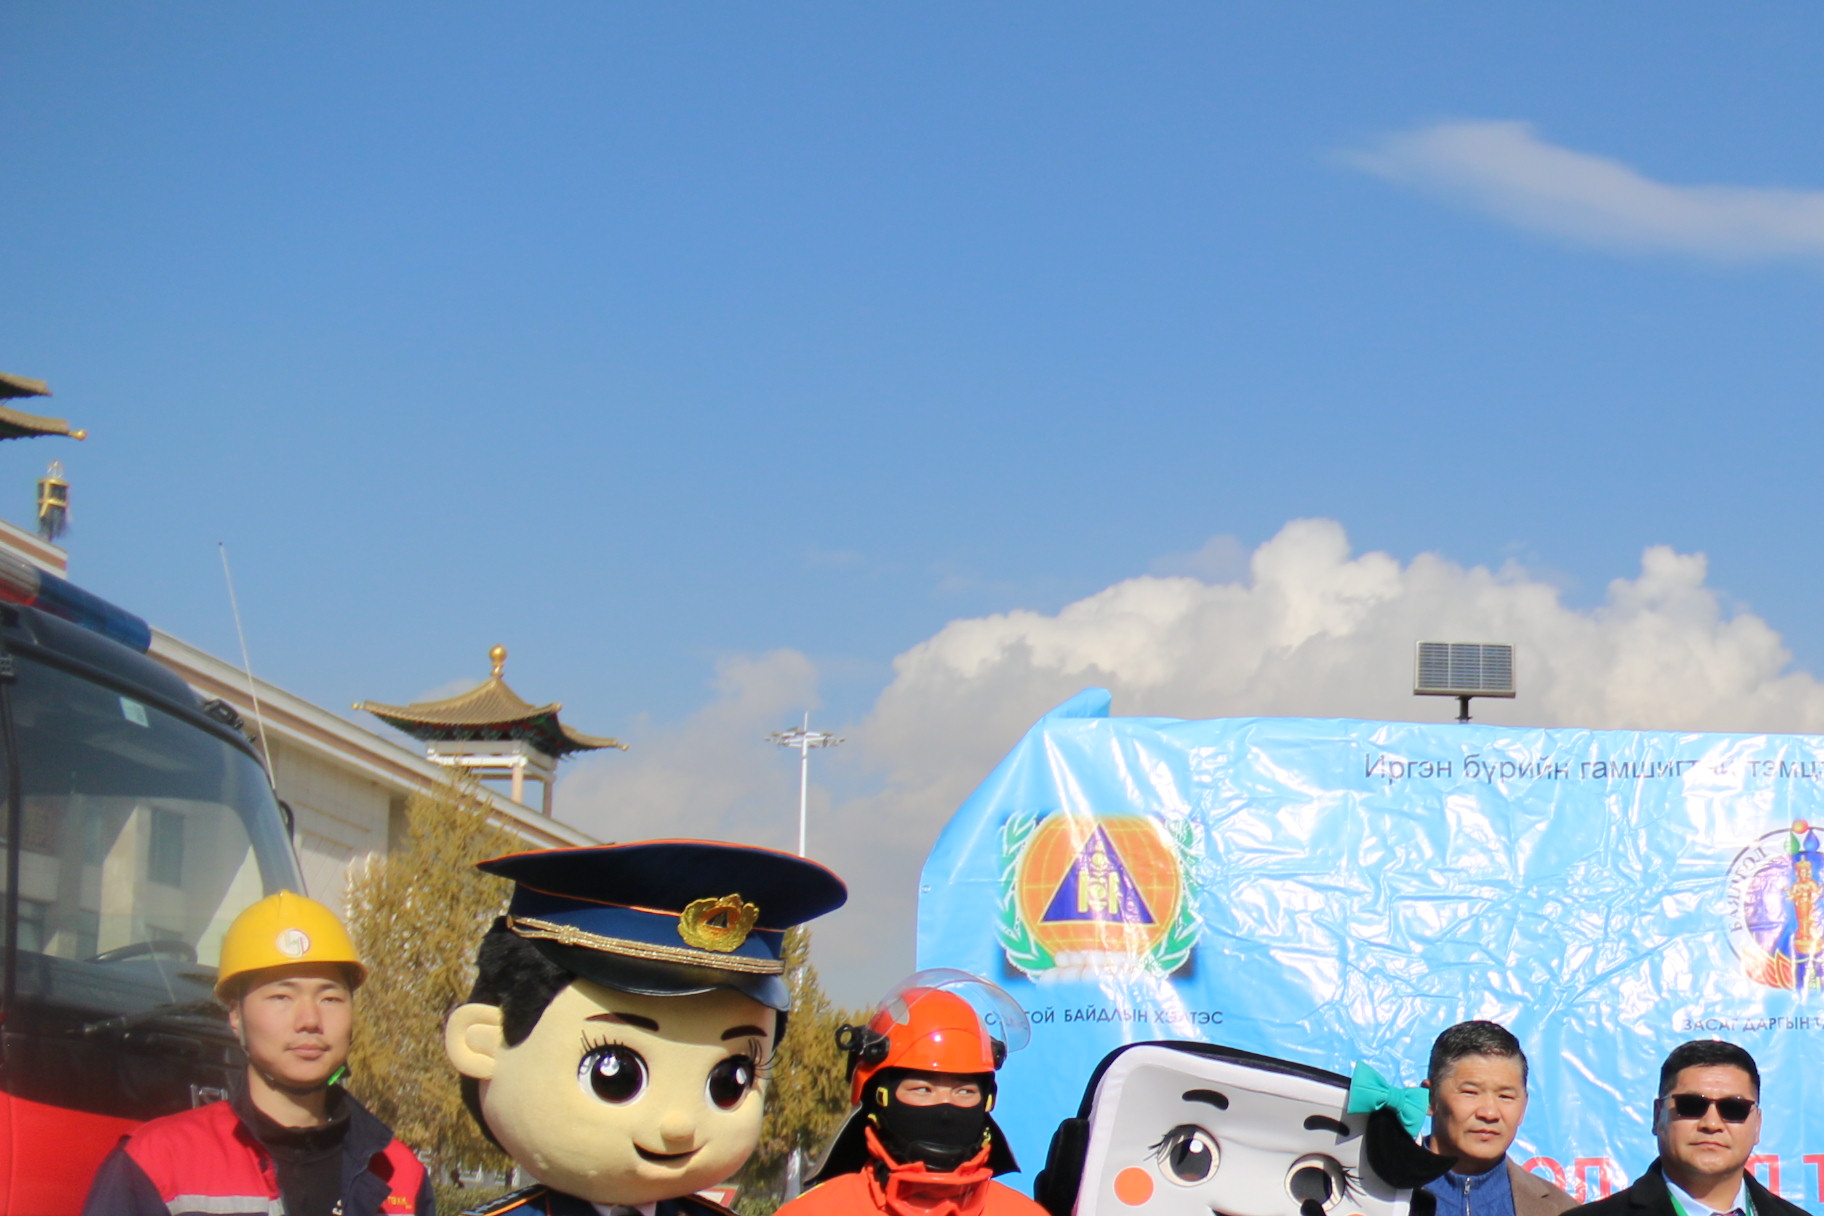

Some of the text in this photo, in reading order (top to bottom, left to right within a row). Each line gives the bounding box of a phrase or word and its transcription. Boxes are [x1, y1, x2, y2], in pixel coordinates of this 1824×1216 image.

[1364, 753, 1453, 784] Иргэн
[1463, 752, 1570, 785] бүрийн
[1064, 1004, 1148, 1026] БАЙДЛЫН
[1683, 1017, 1739, 1032] ЗАСАГ
[1742, 1017, 1810, 1032] ДАРГЫН
